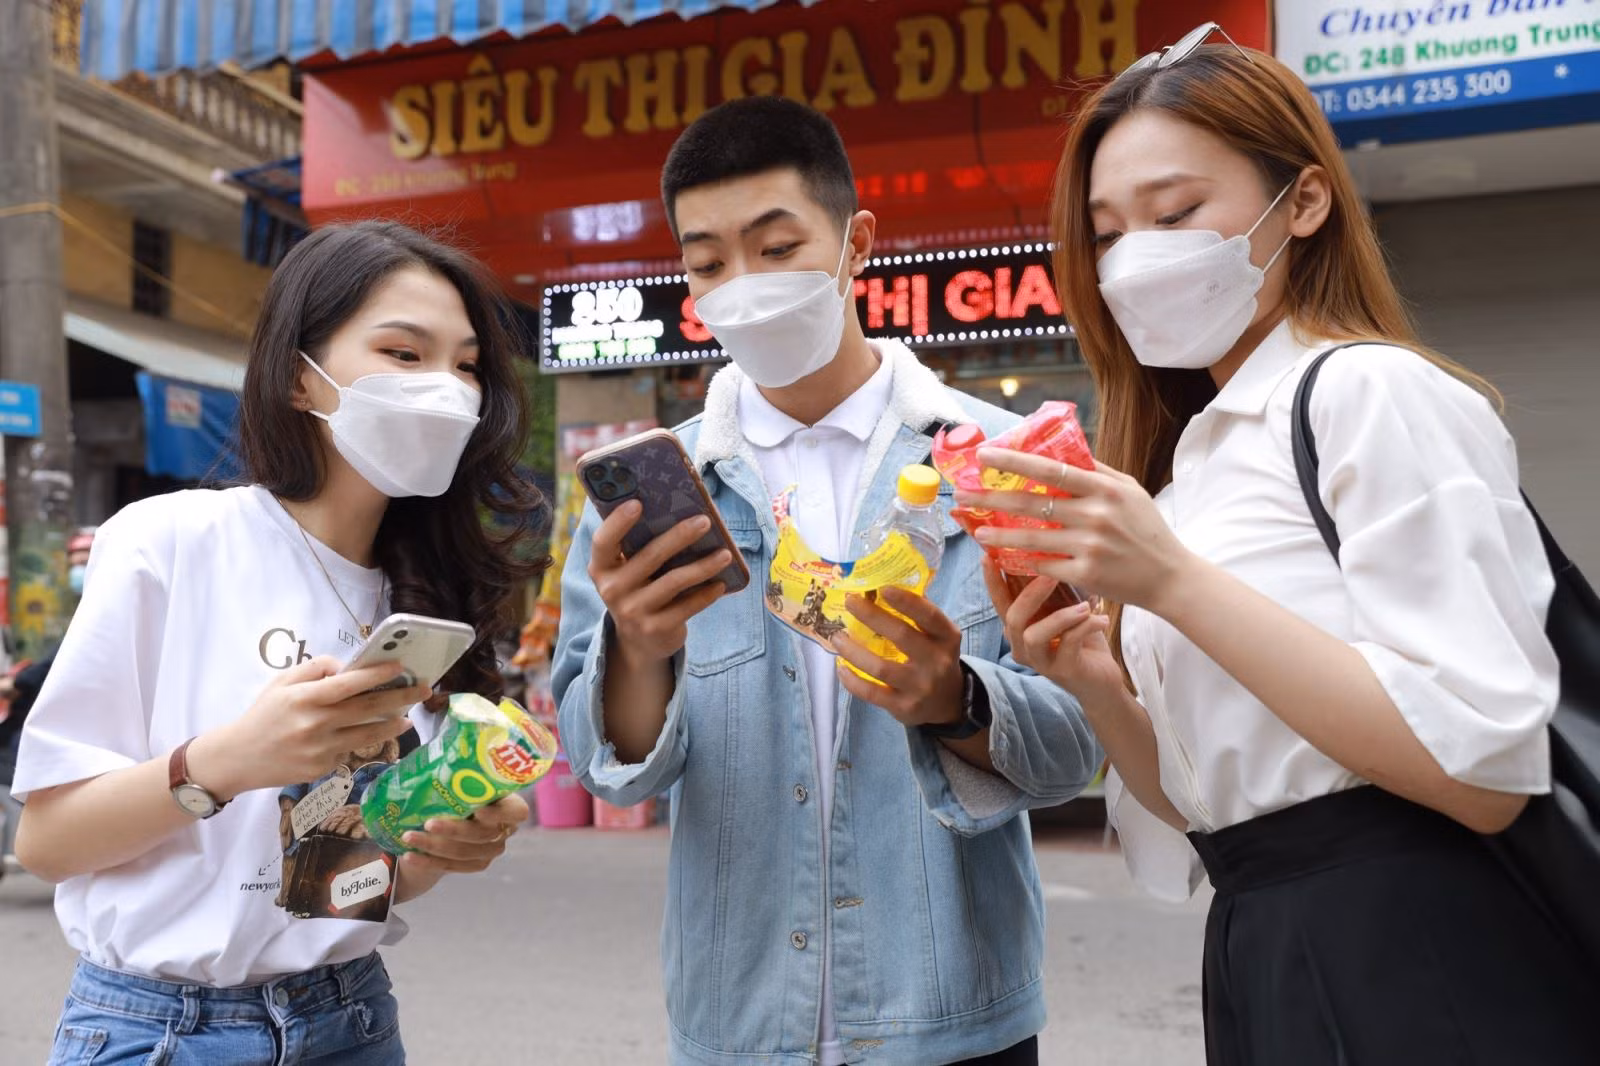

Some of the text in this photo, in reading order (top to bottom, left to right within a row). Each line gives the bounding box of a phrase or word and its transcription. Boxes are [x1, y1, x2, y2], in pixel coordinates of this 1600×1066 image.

[390, 53, 558, 160] SIÊU
[721, 27, 876, 111] GIA
[1413, 76, 1457, 104] 235
[1464, 69, 1511, 96] 300
[944, 264, 1064, 322] GIA
